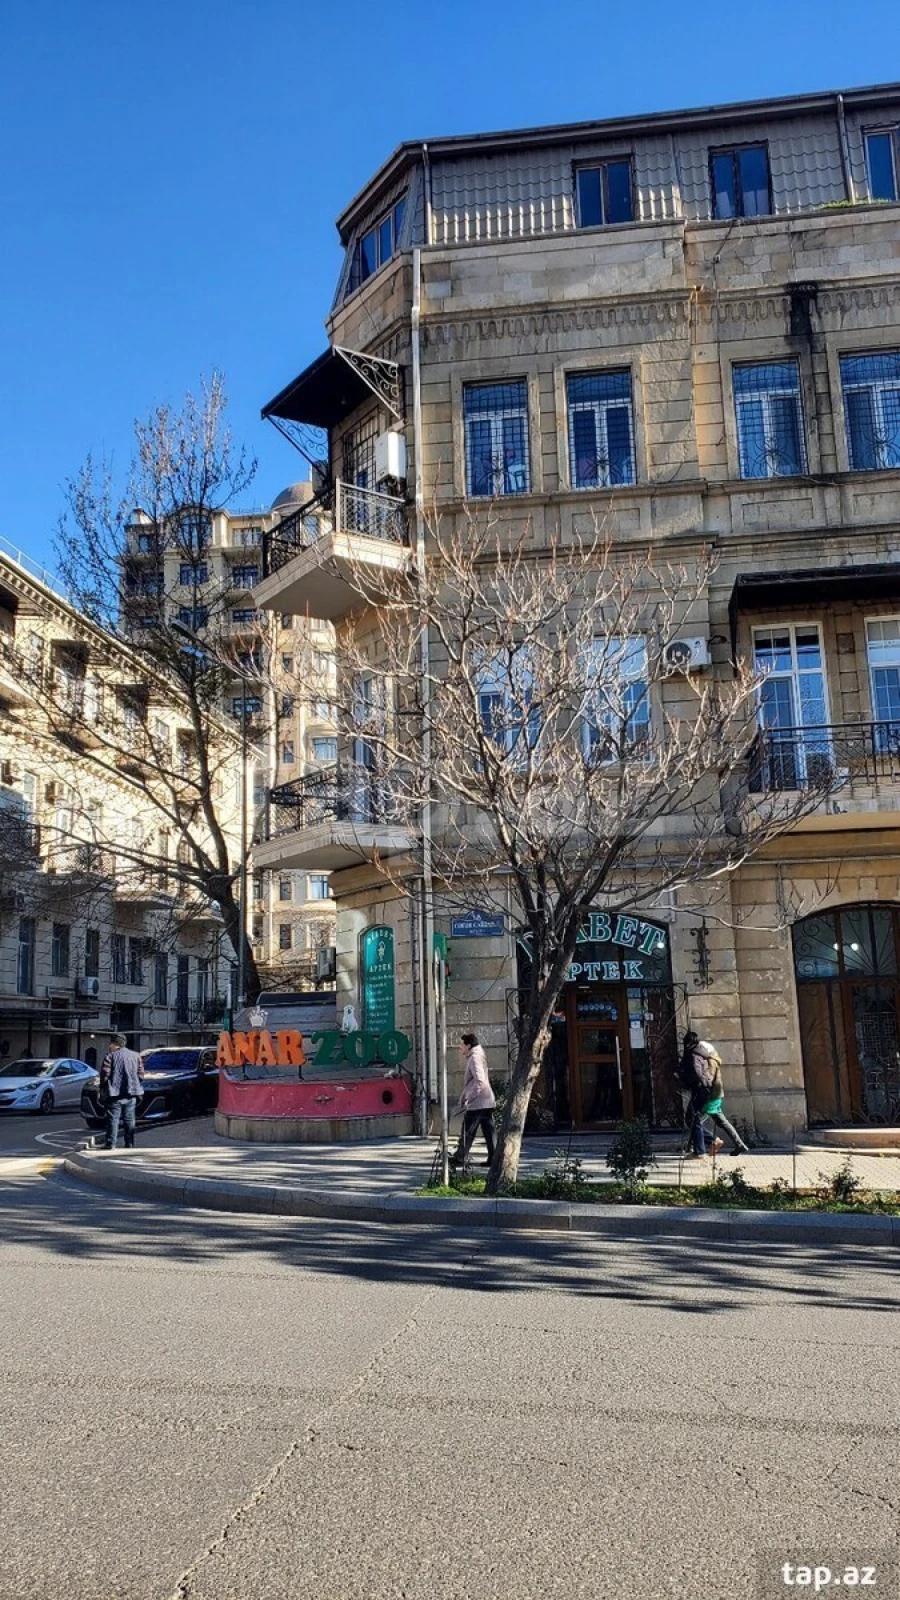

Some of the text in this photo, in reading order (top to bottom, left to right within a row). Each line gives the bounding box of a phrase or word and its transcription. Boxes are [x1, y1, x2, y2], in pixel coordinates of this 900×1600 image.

[564, 960, 644, 981] PTEK
[215, 1028, 409, 1066] ANAR ZOO
